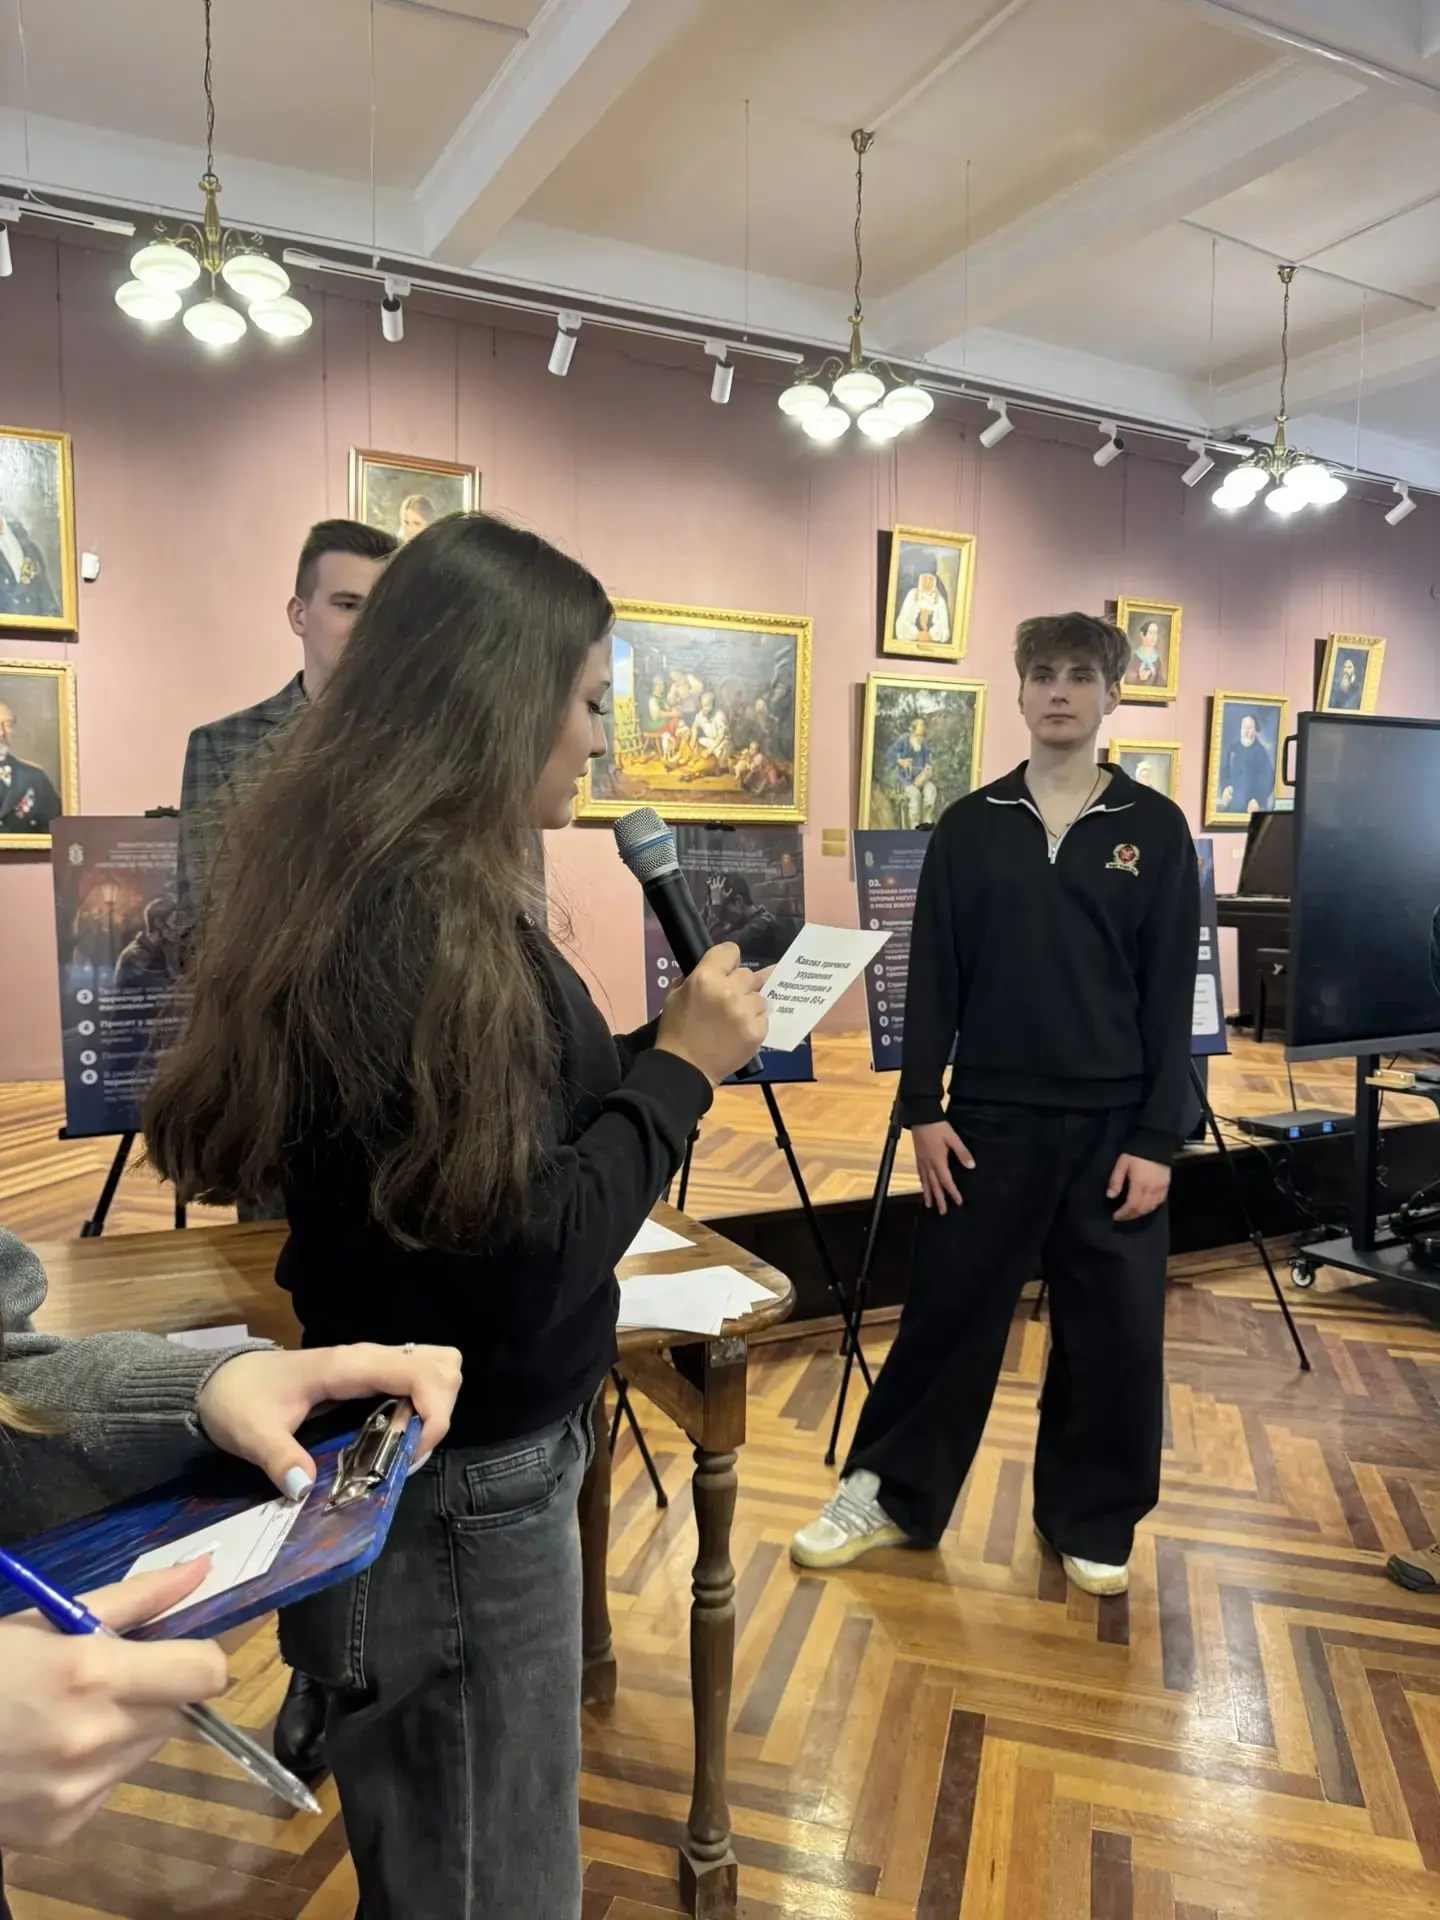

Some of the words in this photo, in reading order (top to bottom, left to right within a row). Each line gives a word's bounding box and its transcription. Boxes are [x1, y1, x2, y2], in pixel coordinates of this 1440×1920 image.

[795, 955, 821, 968] Какова
[820, 959, 851, 970] причина
[767, 989, 792, 1002] России
[790, 994, 810, 1004] после
